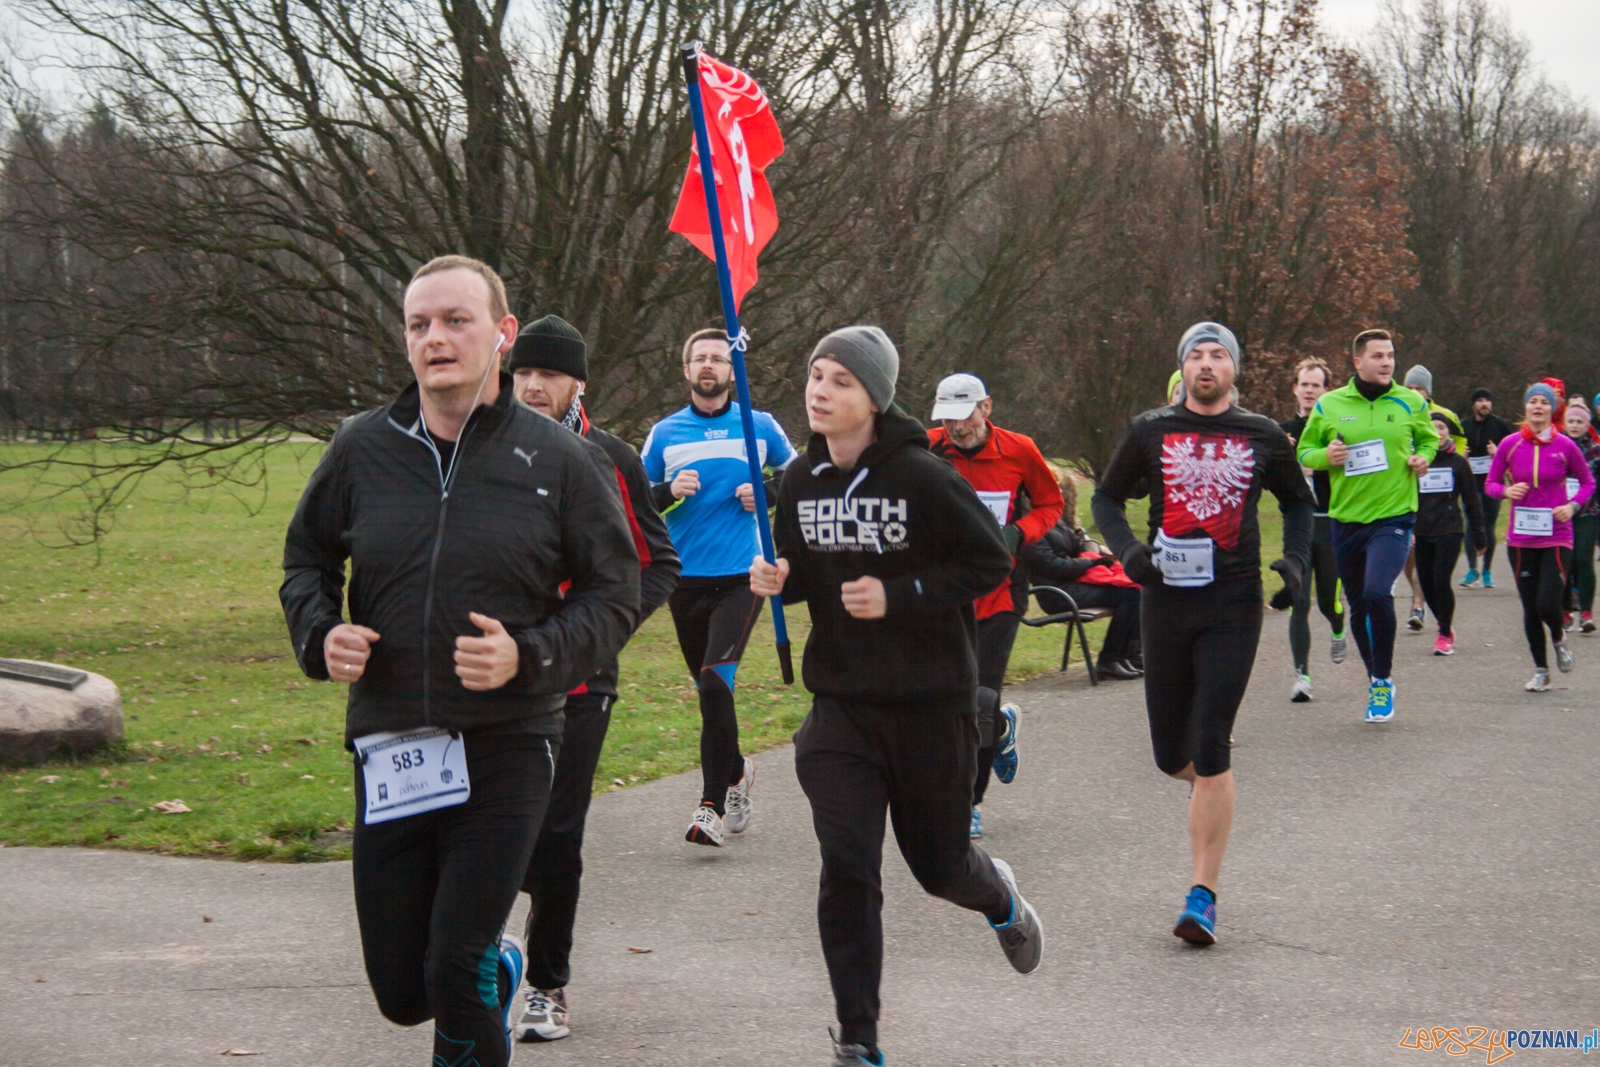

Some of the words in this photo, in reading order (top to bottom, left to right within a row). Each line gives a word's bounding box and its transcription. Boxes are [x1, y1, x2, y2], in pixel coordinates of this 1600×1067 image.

[798, 498, 907, 523] SOUTH
[800, 522, 879, 544] POLE
[865, 541, 910, 554] COECTION
[1165, 550, 1188, 563] 861
[392, 748, 425, 773] 583
